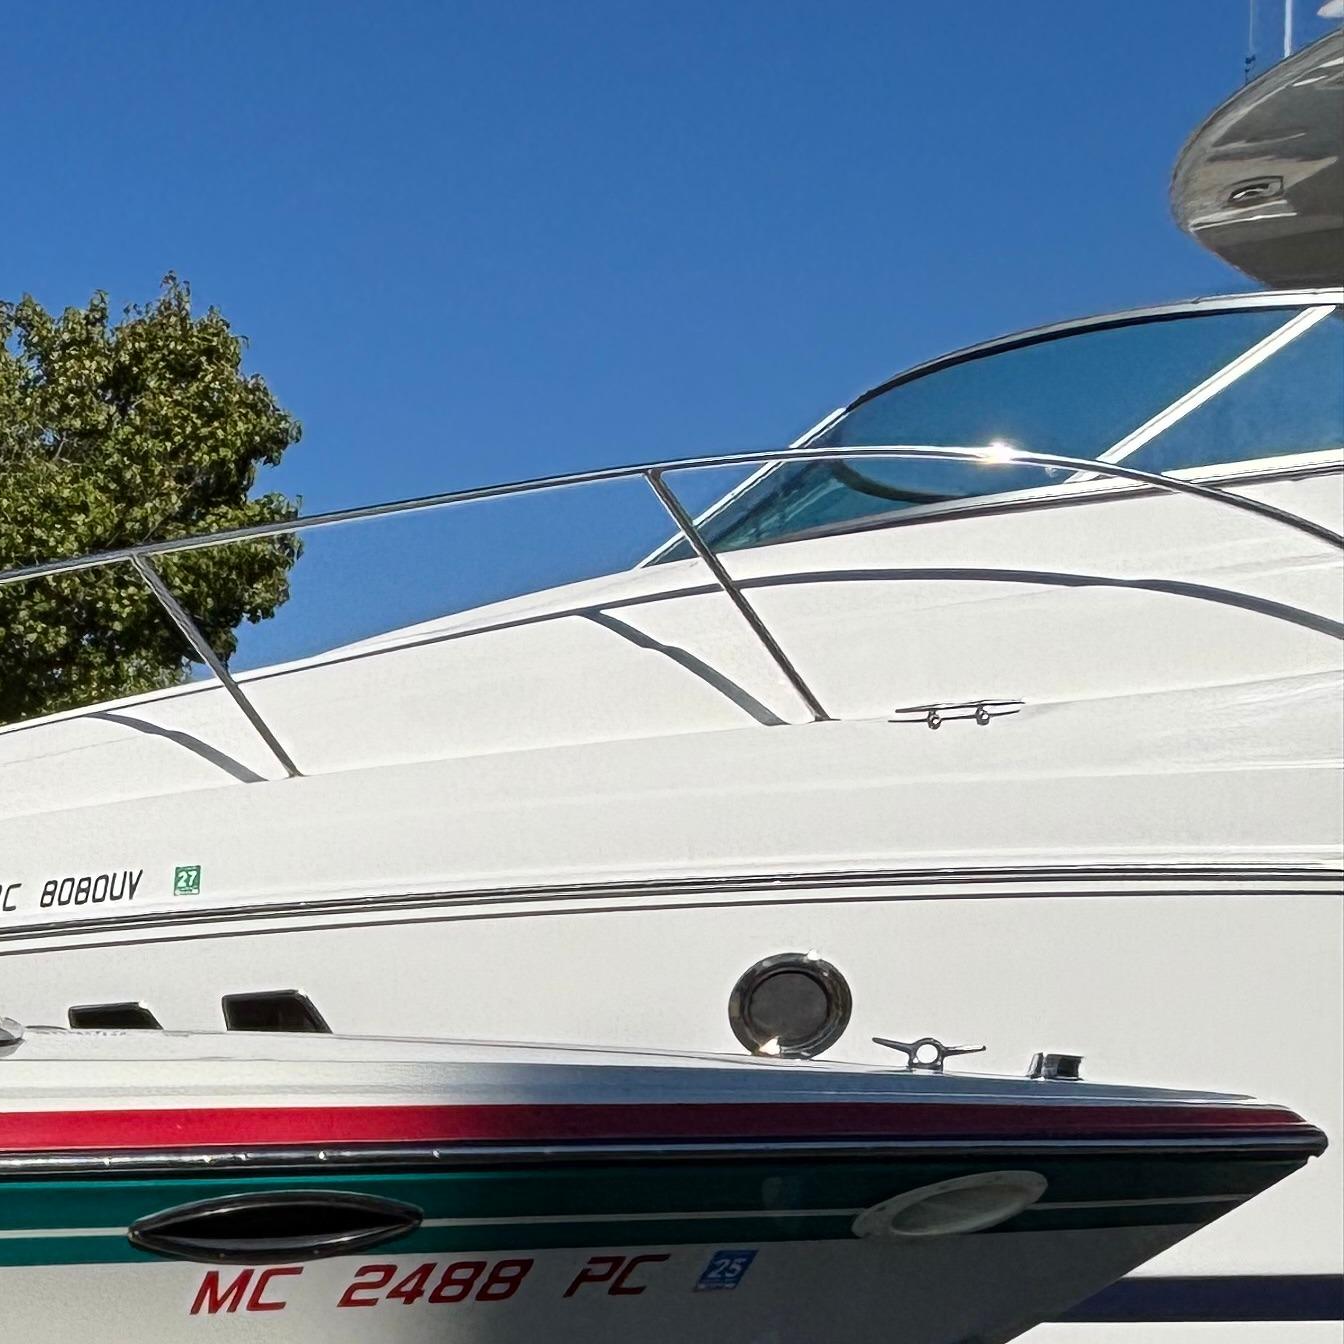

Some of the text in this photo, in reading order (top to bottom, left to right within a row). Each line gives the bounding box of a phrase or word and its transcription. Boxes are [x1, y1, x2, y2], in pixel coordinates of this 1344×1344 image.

[39, 869, 144, 908] 8080UV
[177, 870, 198, 887] 27
[707, 1258, 747, 1278] 25
[189, 1253, 671, 1315] MC 2488 PC
